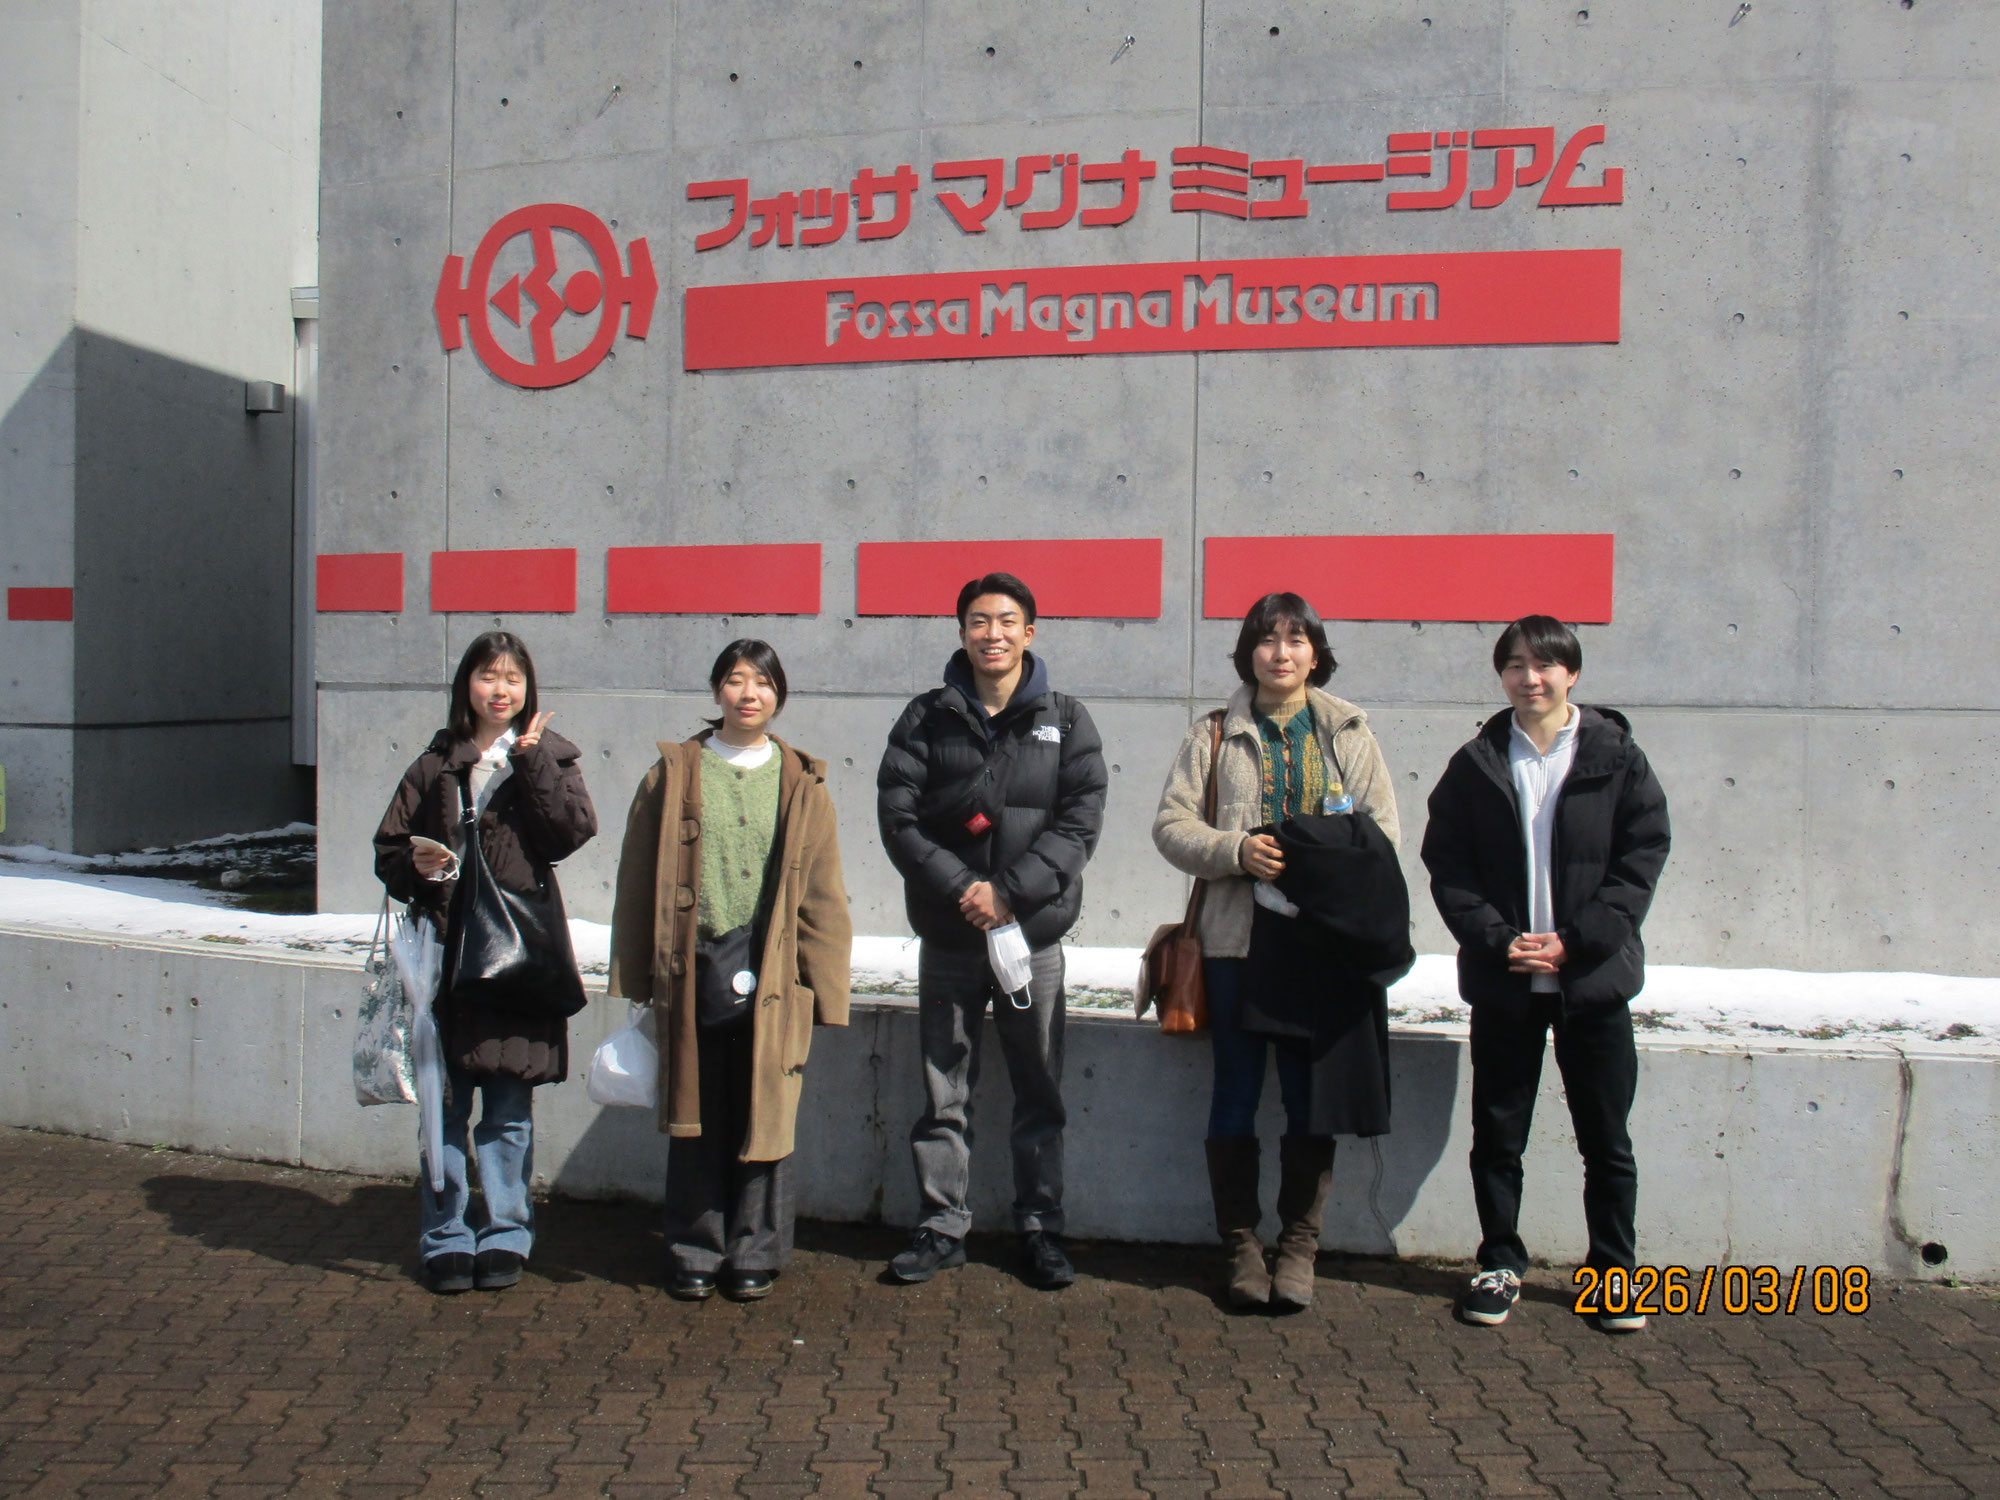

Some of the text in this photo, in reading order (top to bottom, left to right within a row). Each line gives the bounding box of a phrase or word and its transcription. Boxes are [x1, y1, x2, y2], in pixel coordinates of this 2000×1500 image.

[825, 273, 1440, 347] Fossa Magna Museum
